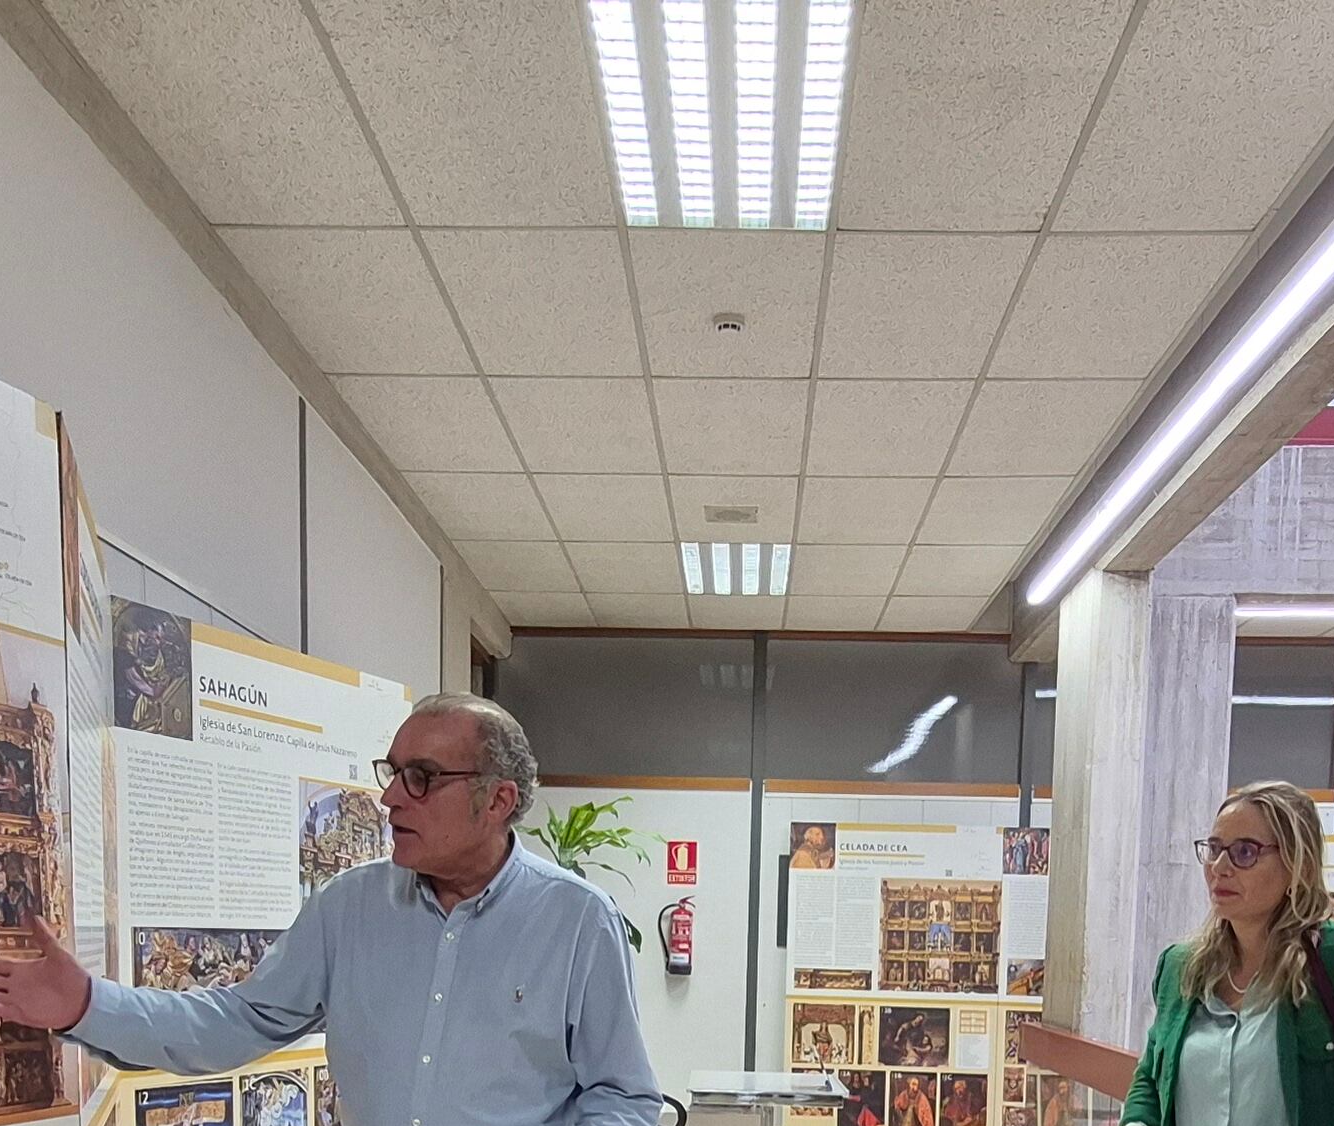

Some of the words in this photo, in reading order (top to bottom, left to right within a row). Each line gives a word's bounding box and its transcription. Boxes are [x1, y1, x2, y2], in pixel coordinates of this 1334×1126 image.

[199, 676, 267, 707] SAHAGÚN
[200, 715, 225, 731] Iglesia
[227, 722, 236, 733] de
[238, 723, 252, 736] San
[839, 843, 875, 851] CELADA
[890, 844, 908, 852] CEA
